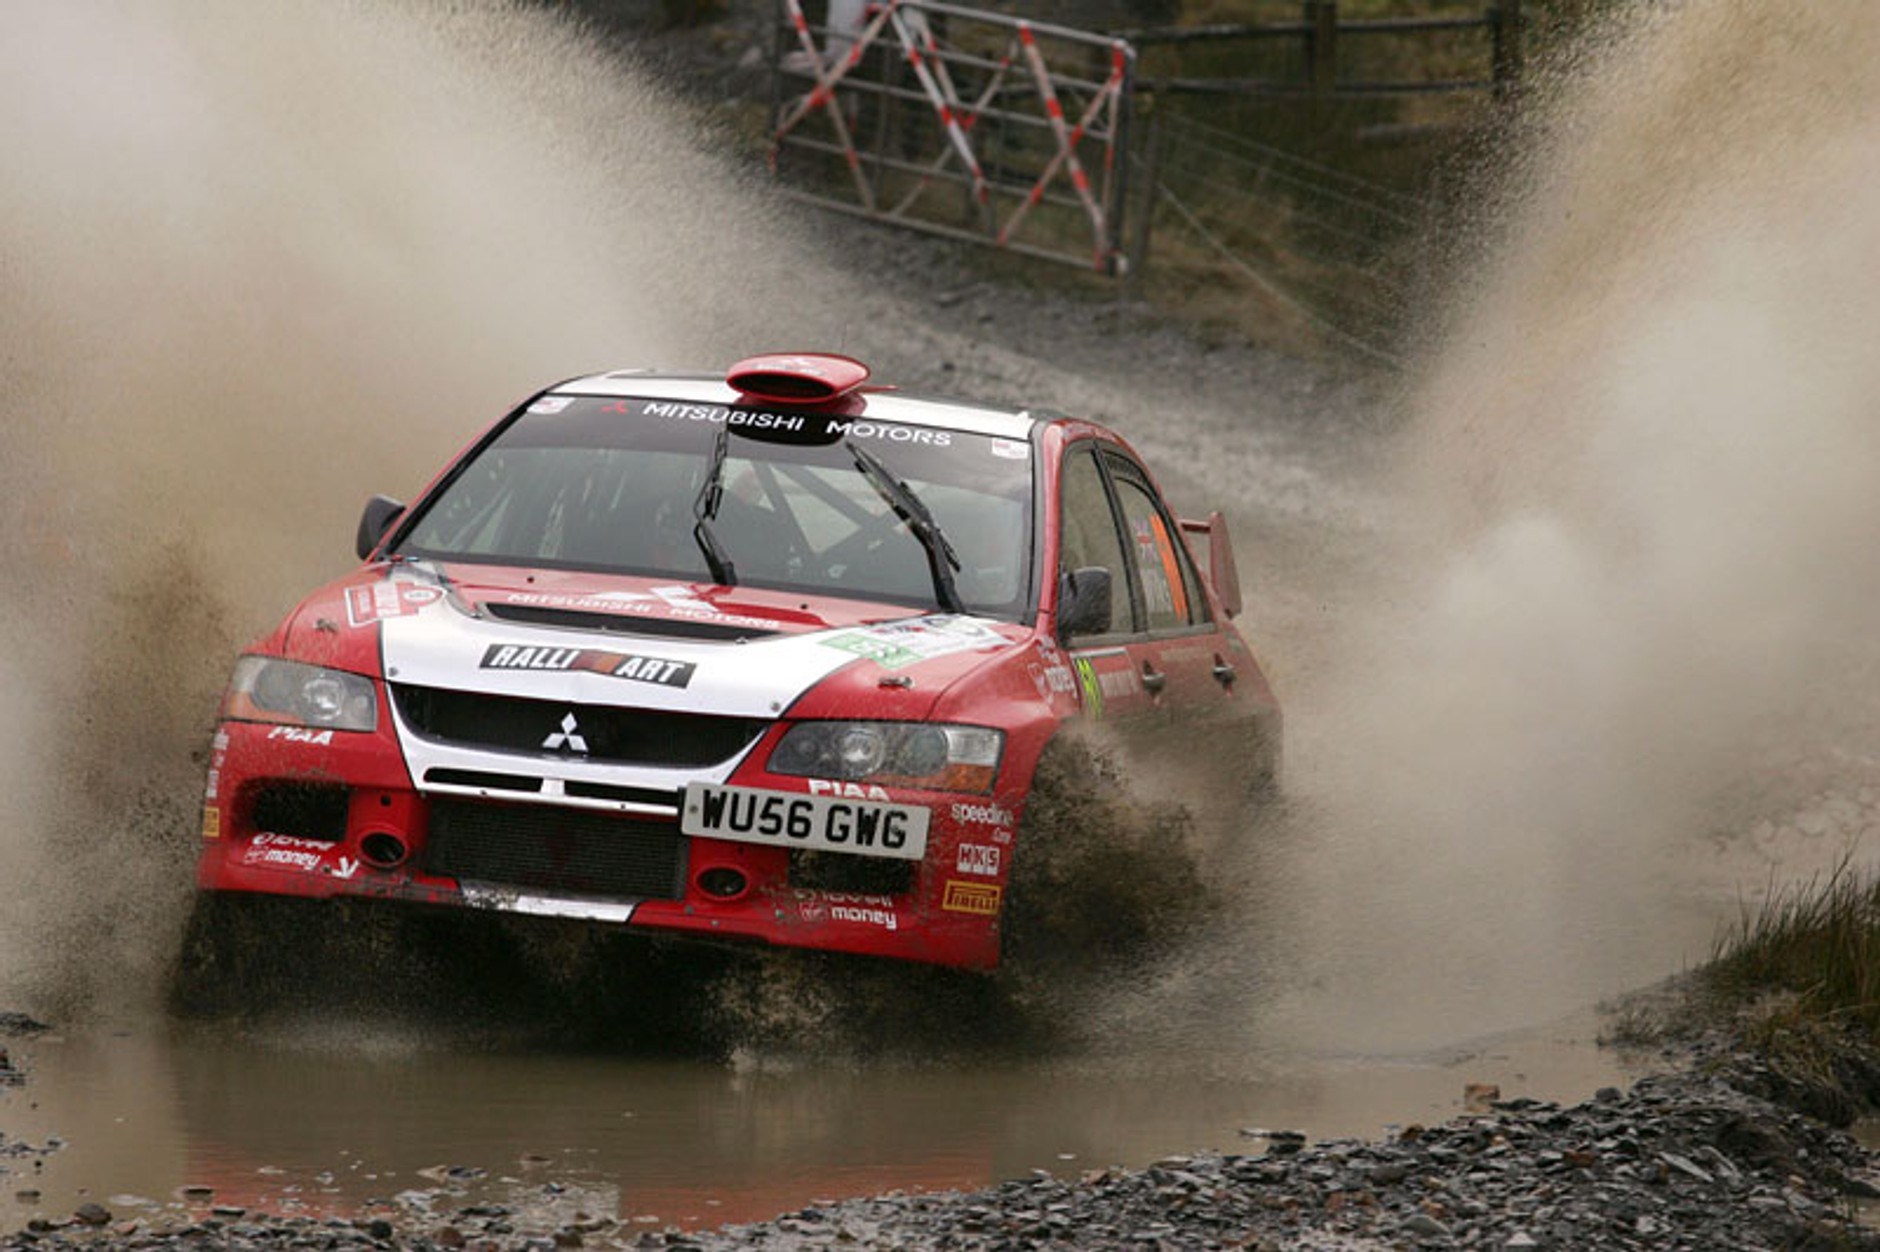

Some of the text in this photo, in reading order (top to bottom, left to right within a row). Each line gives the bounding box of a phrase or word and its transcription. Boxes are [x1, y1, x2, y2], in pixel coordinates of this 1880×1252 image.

[643, 402, 951, 446] MITSUBISHI MOTORS
[489, 646, 685, 683] RALLI ART
[808, 778, 890, 801] PIAA
[702, 788, 909, 849] WU56 GWG
[265, 848, 321, 871] money
[959, 845, 999, 870] HKS
[832, 906, 897, 931] money
